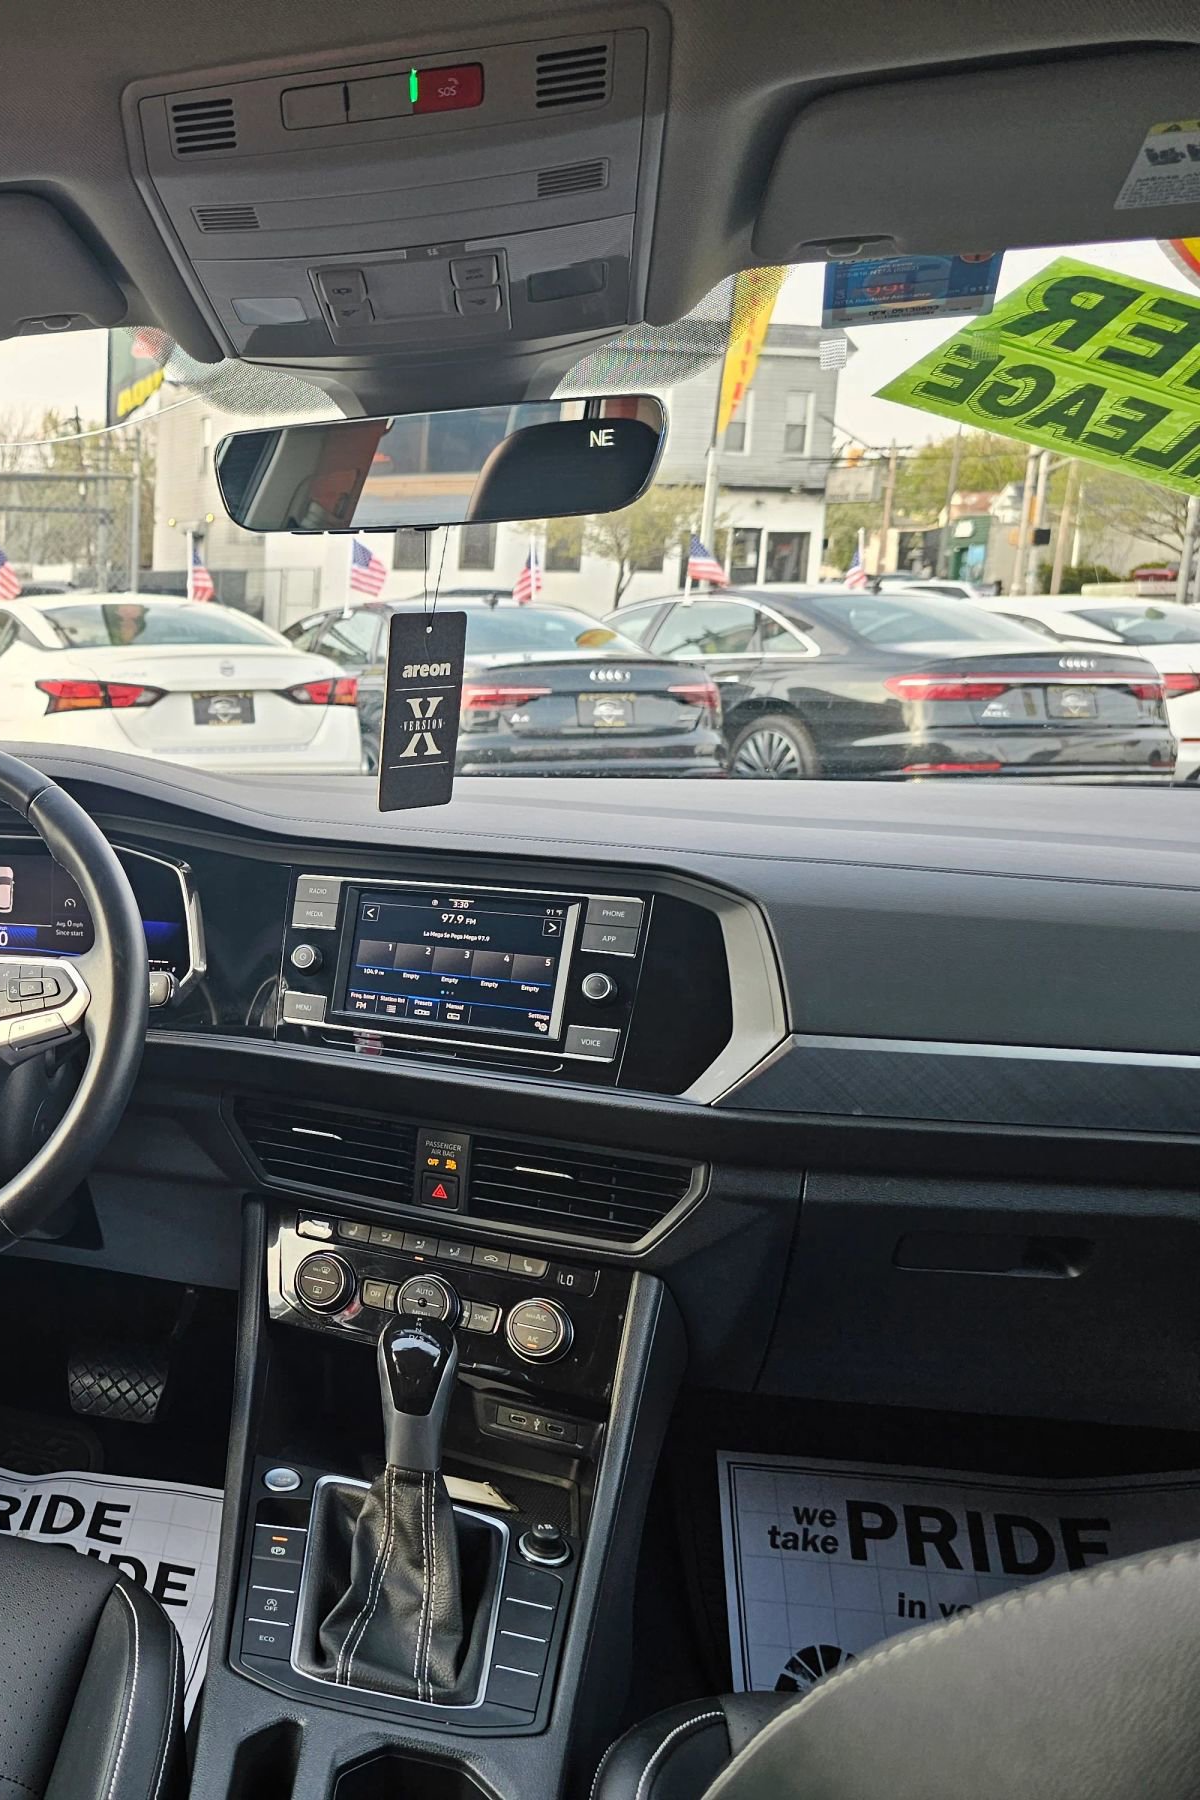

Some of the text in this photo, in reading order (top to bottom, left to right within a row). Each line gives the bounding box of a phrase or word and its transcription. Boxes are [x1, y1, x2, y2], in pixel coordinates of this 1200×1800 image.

[438, 86, 457, 97] SOS
[590, 428, 615, 448] NE
[402, 662, 451, 678] areon
[403, 718, 443, 731] VERSION
[308, 887, 328, 895] RADIO
[453, 901, 470, 910] 3:30
[305, 910, 325, 918] MEDIA
[602, 909, 626, 918] PHONE
[441, 913, 477, 926] 97.9 FM
[55, 929, 71, 937] Since
[602, 935, 617, 943] APP
[425, 947, 432, 956] 2
[464, 950, 471, 960] 3
[503, 954, 510, 963] 4
[363, 968, 378, 976] 104.9
[402, 972, 540, 994] Empty Empty Empty Empty
[380, 994, 398, 1003] Station
[414, 999, 433, 1007] Presets
[295, 1003, 312, 1011] MENU
[355, 1001, 367, 1010] FM
[445, 1002, 464, 1011] Manual
[527, 1011, 550, 1021] Settings
[580, 1038, 601, 1047] VOICE
[425, 1140, 462, 1152] PASSENGER
[431, 1148, 455, 1158] AIR BAG
[427, 1157, 440, 1167] OFF
[560, 1273, 574, 1286] LO
[370, 1290, 381, 1298] OFF
[415, 1287, 434, 1297] AUTO
[473, 1313, 489, 1323] SYNC
[527, 1335, 539, 1344] A/C
[793, 1505, 837, 1528] we
[768, 1525, 839, 1555] take
[846, 1499, 1112, 1577] PRIDE
[264, 1604, 279, 1613] OFF
[898, 1592, 926, 1620] in
[259, 1635, 275, 1643] ECO
